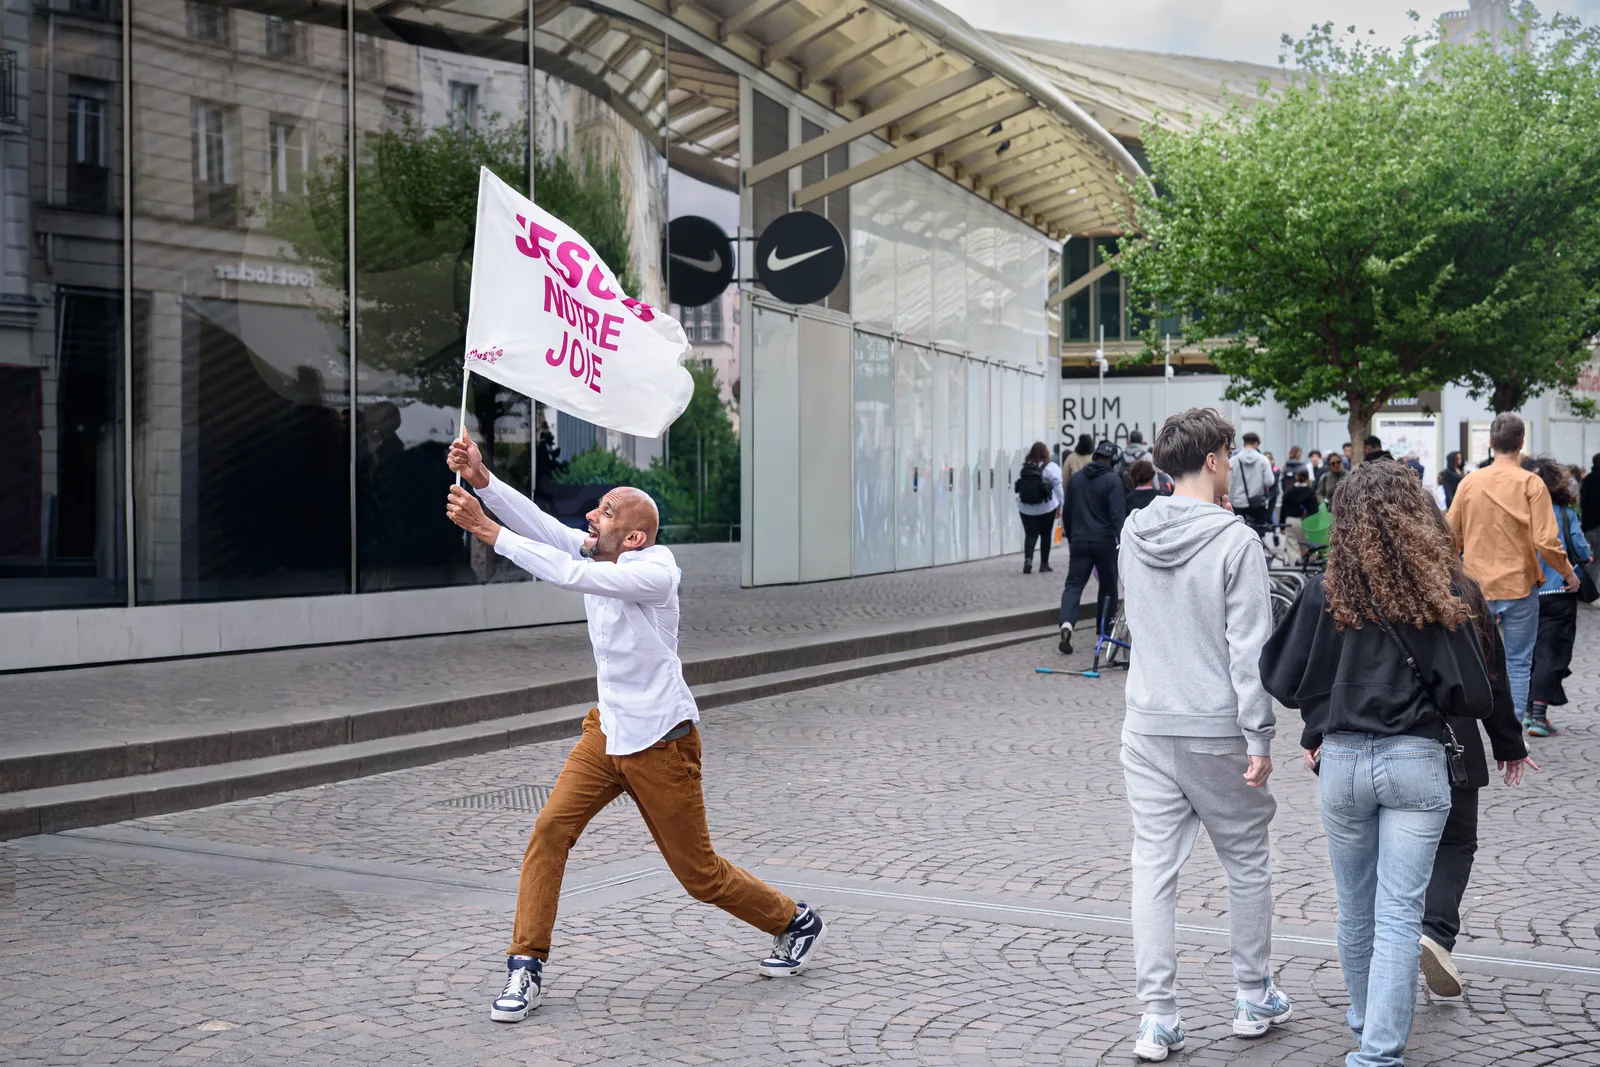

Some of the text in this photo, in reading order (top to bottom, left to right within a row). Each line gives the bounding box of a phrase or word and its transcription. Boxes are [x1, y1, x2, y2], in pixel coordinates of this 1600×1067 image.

[543, 275, 625, 352] NOTRE
[545, 331, 603, 394] JOIE
[1062, 396, 1120, 420] RUM
